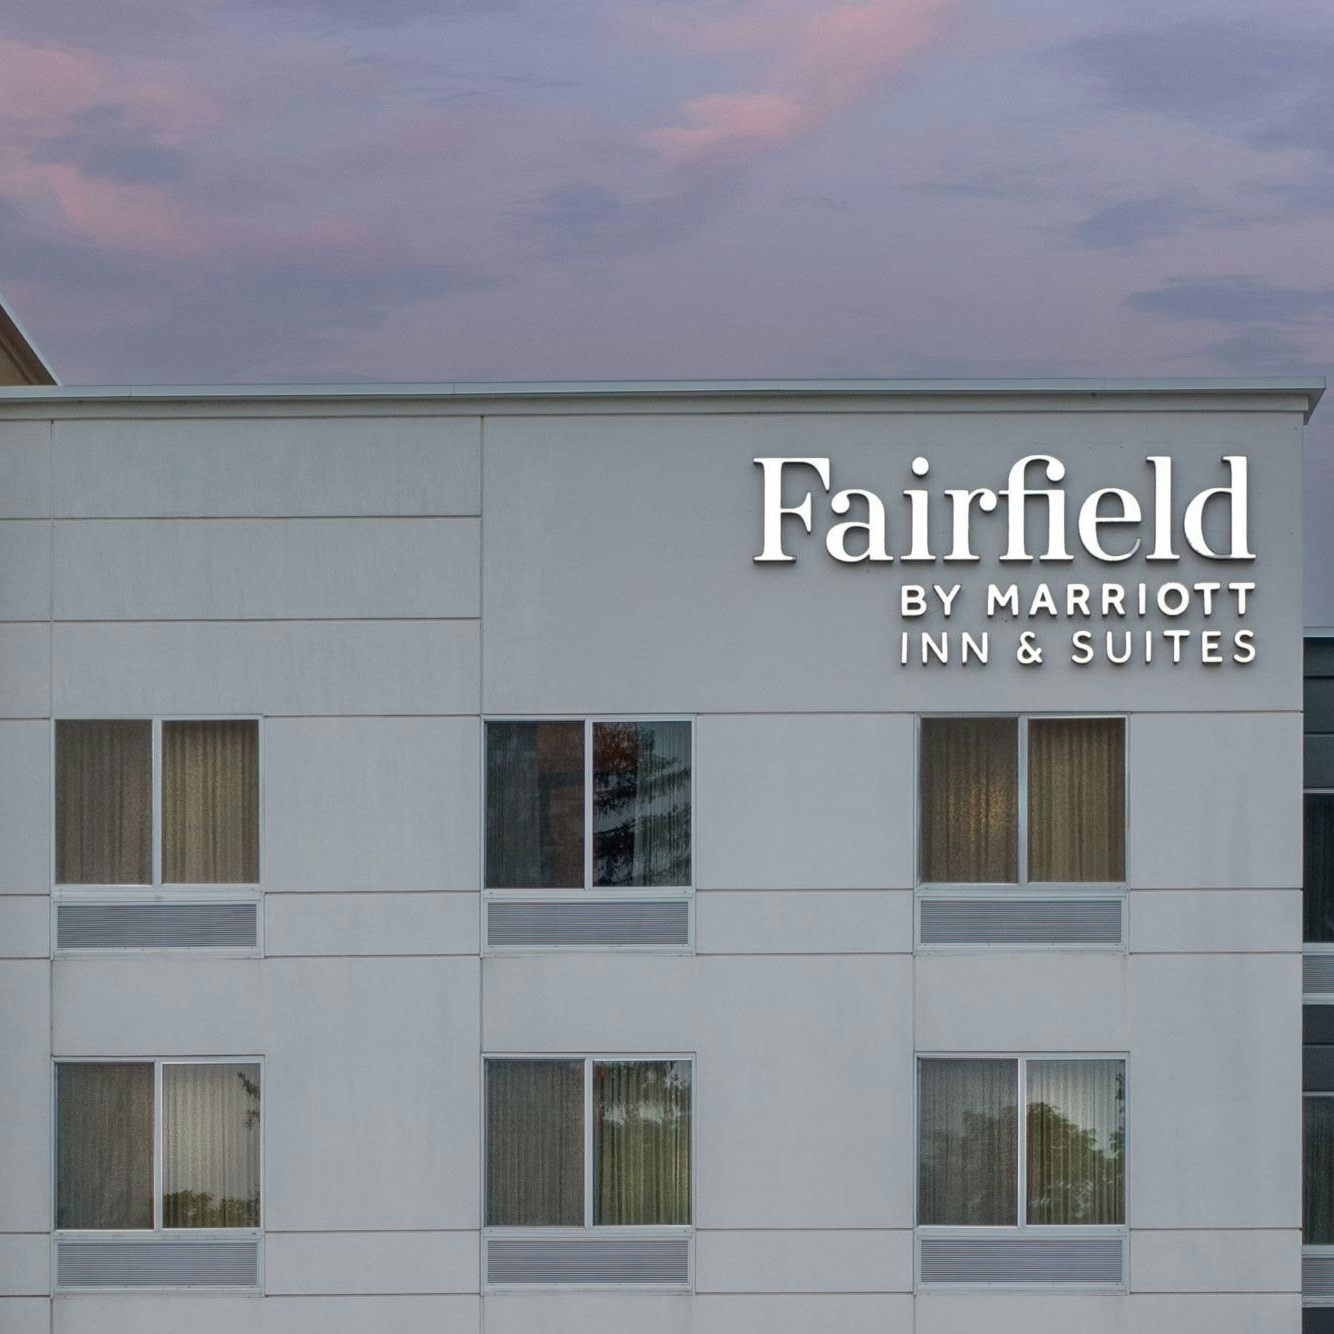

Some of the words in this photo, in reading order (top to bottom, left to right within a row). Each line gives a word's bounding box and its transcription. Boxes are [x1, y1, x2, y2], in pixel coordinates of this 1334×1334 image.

[753, 454, 1257, 562] Fairfield
[901, 582, 962, 616] BY
[987, 582, 1256, 616] MARRIOTT
[901, 630, 989, 664] INN
[1016, 630, 1044, 664] &
[1071, 629, 1257, 664] SUITES
